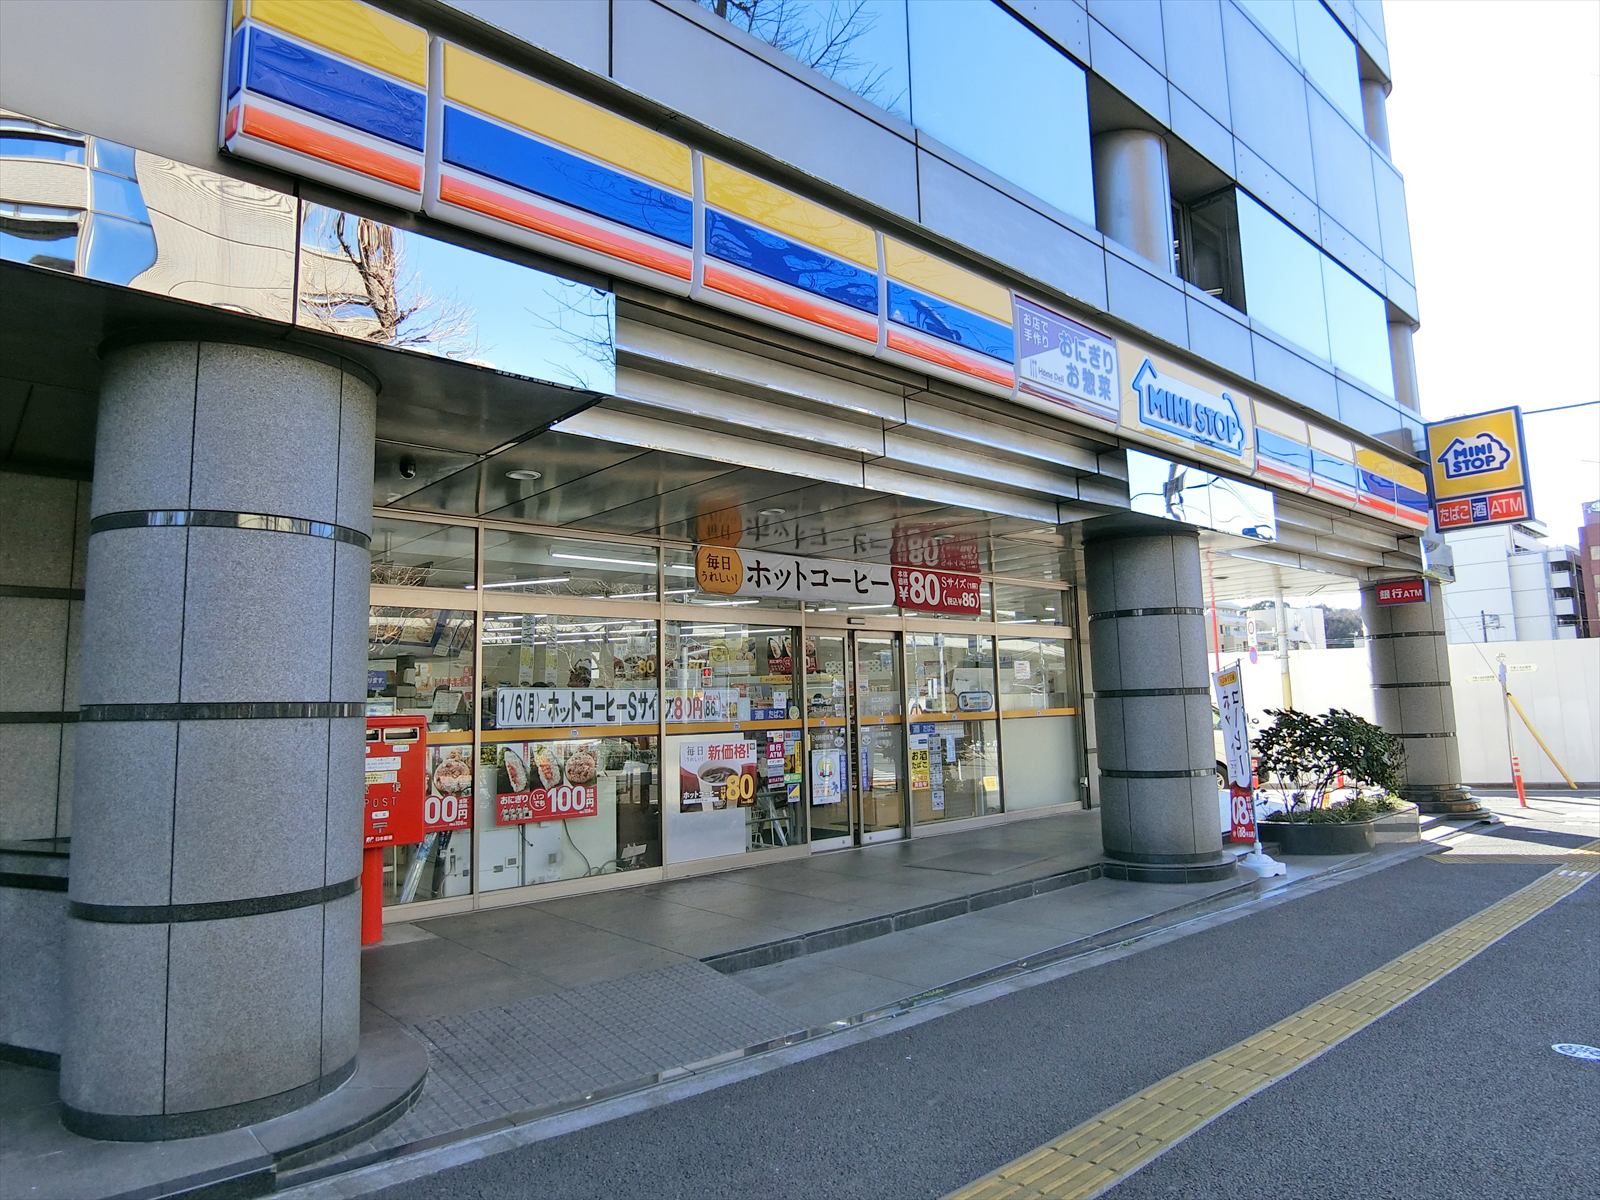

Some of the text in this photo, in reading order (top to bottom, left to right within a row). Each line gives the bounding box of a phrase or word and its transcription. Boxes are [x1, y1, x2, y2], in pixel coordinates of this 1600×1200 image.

[1023, 313, 1048, 334] お店で
[1024, 328, 1049, 348] 手作り
[1058, 330, 1113, 375] おにぎり
[1038, 366, 1053, 380] Home
[1054, 372, 1065, 383] Deli
[1066, 362, 1112, 401] お惣菜
[1147, 383, 1238, 443] MINI STOP
[1453, 442, 1493, 460] MINI
[1453, 454, 1497, 473] STOP
[1439, 501, 1487, 523] たばこ 酒
[1490, 496, 1523, 516] ATM
[706, 553, 731, 571] 毎日
[701, 570, 739, 586] うれしい!
[746, 559, 890, 595] ホットコーヒー
[754, 709, 785, 720] 酒 たばこ
[912, 723, 935, 733] 酒 たばこ
[686, 745, 704, 757] 毎日
[707, 743, 750, 760] 新価格!
[911, 750, 928, 761] お酒
[911, 761, 928, 769] たばこ
[500, 794, 529, 805] おにぎり
[683, 790, 720, 800] ホットコーヒー
